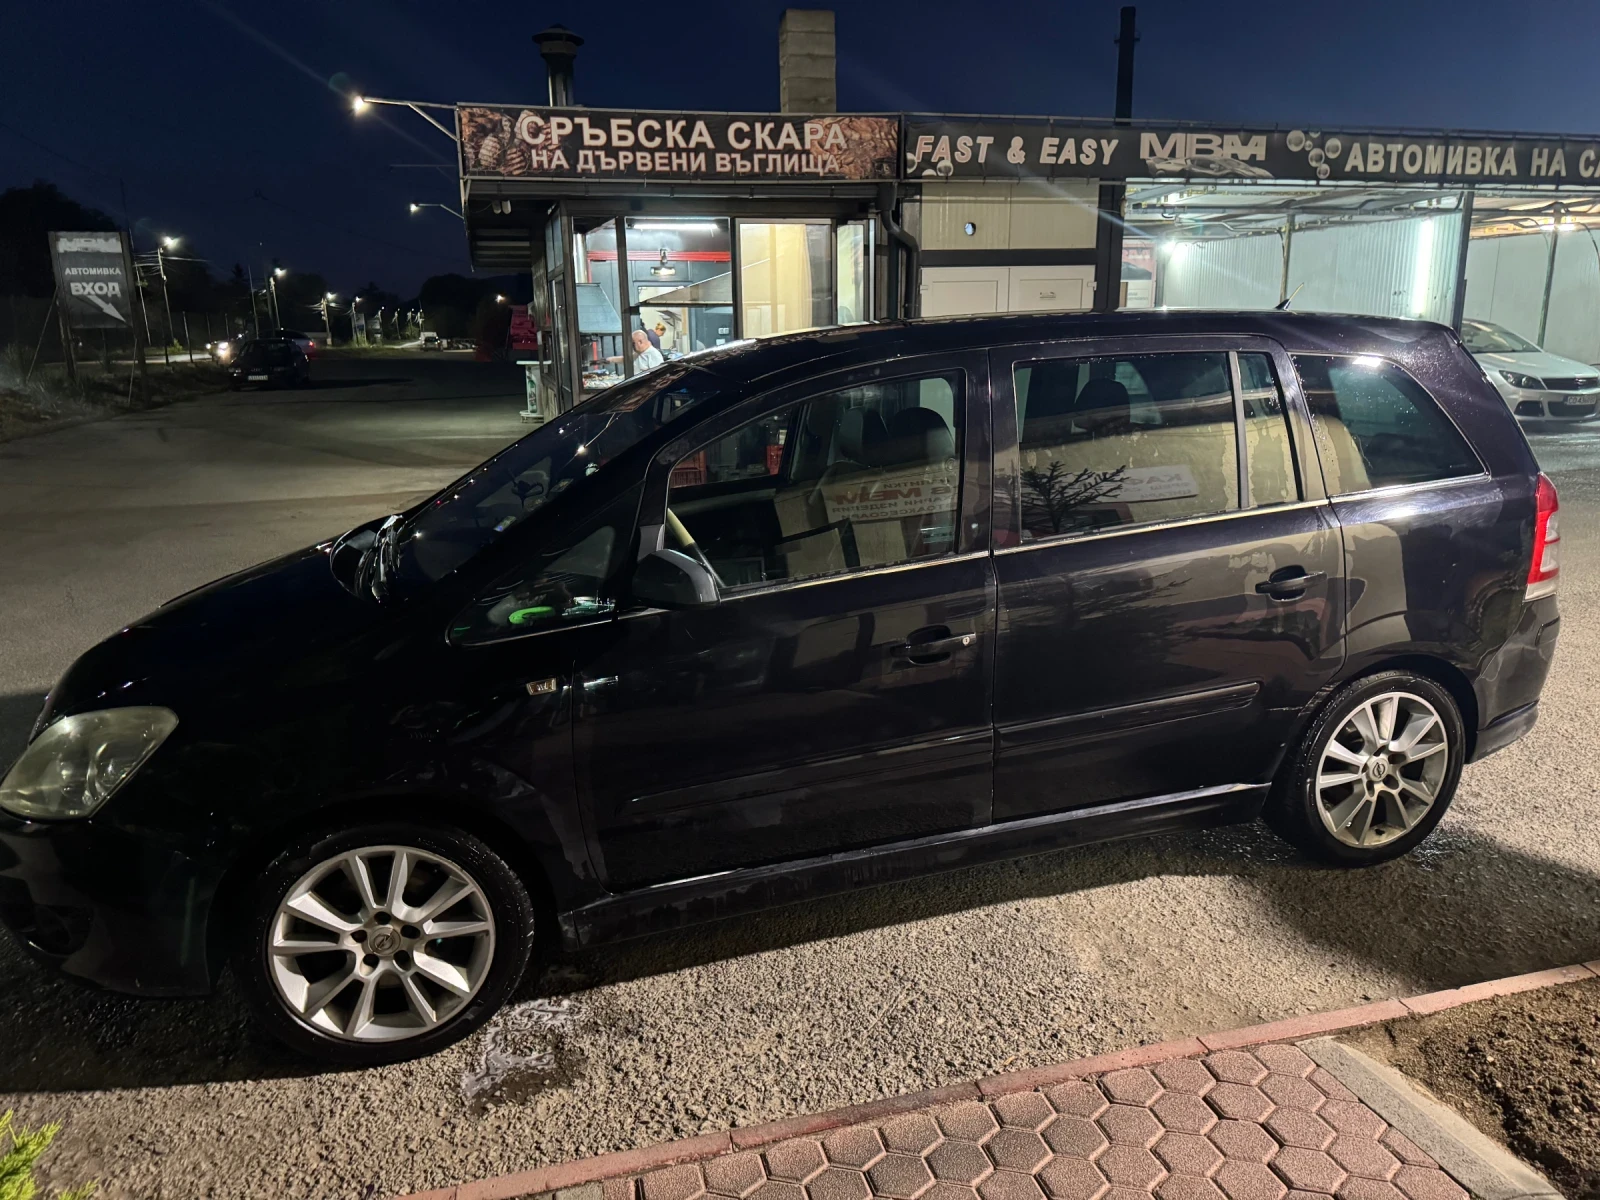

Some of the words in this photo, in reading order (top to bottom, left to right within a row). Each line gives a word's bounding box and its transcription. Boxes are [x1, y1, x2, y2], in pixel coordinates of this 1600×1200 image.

[520, 115, 714, 149] СРЪБСКА
[726, 121, 847, 150] СКАРА
[531, 149, 569, 171] НА
[576, 150, 707, 174] ДЪРВЕНИ
[716, 152, 841, 175] ВЪГЛИЩА
[915, 135, 994, 163] FAST
[1006, 136, 1026, 164] &
[1039, 137, 1119, 165] EASY
[1343, 142, 1518, 176] АВТОМИВКА
[1530, 147, 1567, 177] НА
[64, 267, 121, 276] АВТОМИВКА
[70, 282, 121, 298] ВХОД
